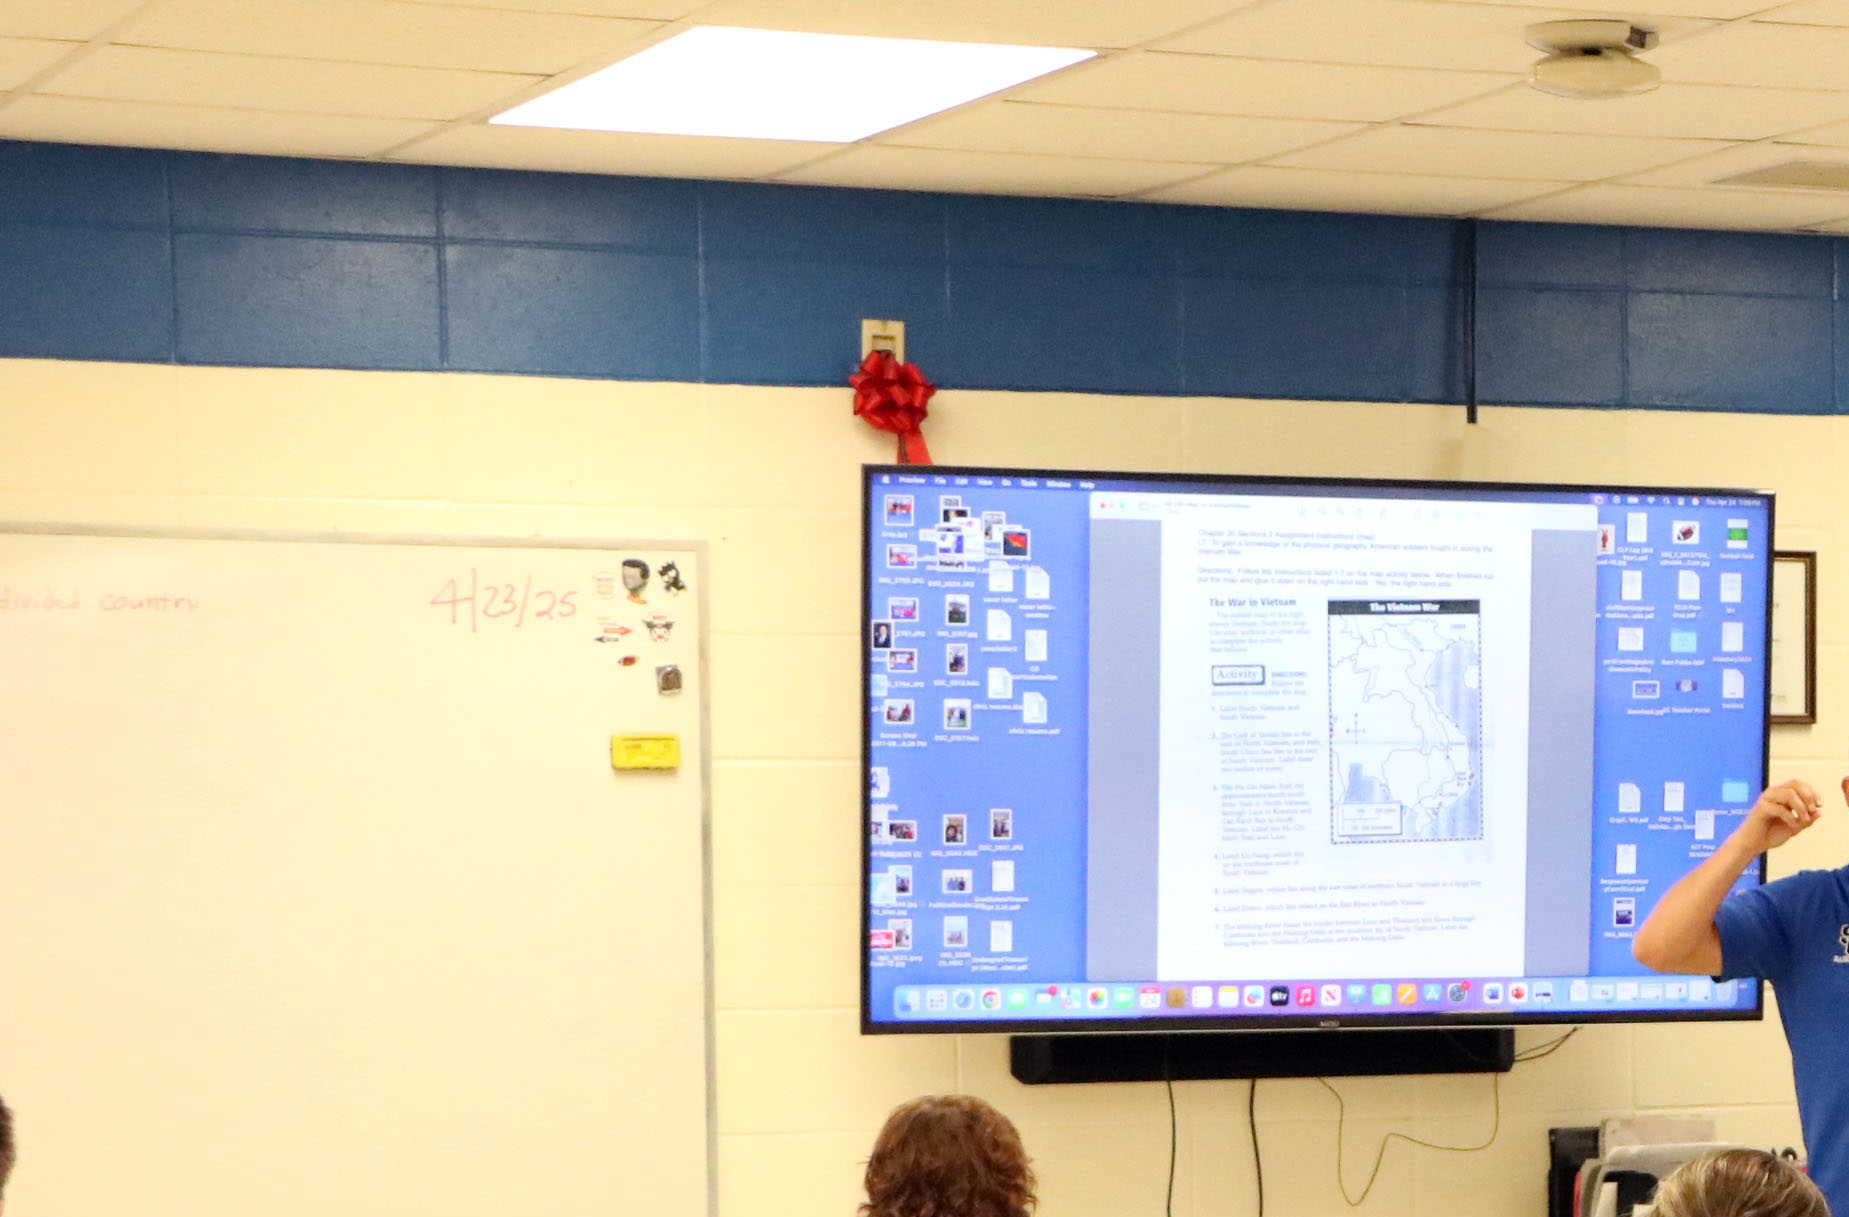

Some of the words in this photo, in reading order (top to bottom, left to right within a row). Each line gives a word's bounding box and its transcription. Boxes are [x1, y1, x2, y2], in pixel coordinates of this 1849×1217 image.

[430, 567, 580, 633] 4/23/25
[1210, 598, 1226, 607] The
[1228, 598, 1246, 607] War
[1250, 598, 1258, 607] in
[1260, 598, 1297, 607] Vietnam
[1370, 603, 1386, 612] The
[1386, 603, 1422, 612] Vietnam
[1422, 603, 1440, 612] War
[1217, 668, 1258, 681] Activity
